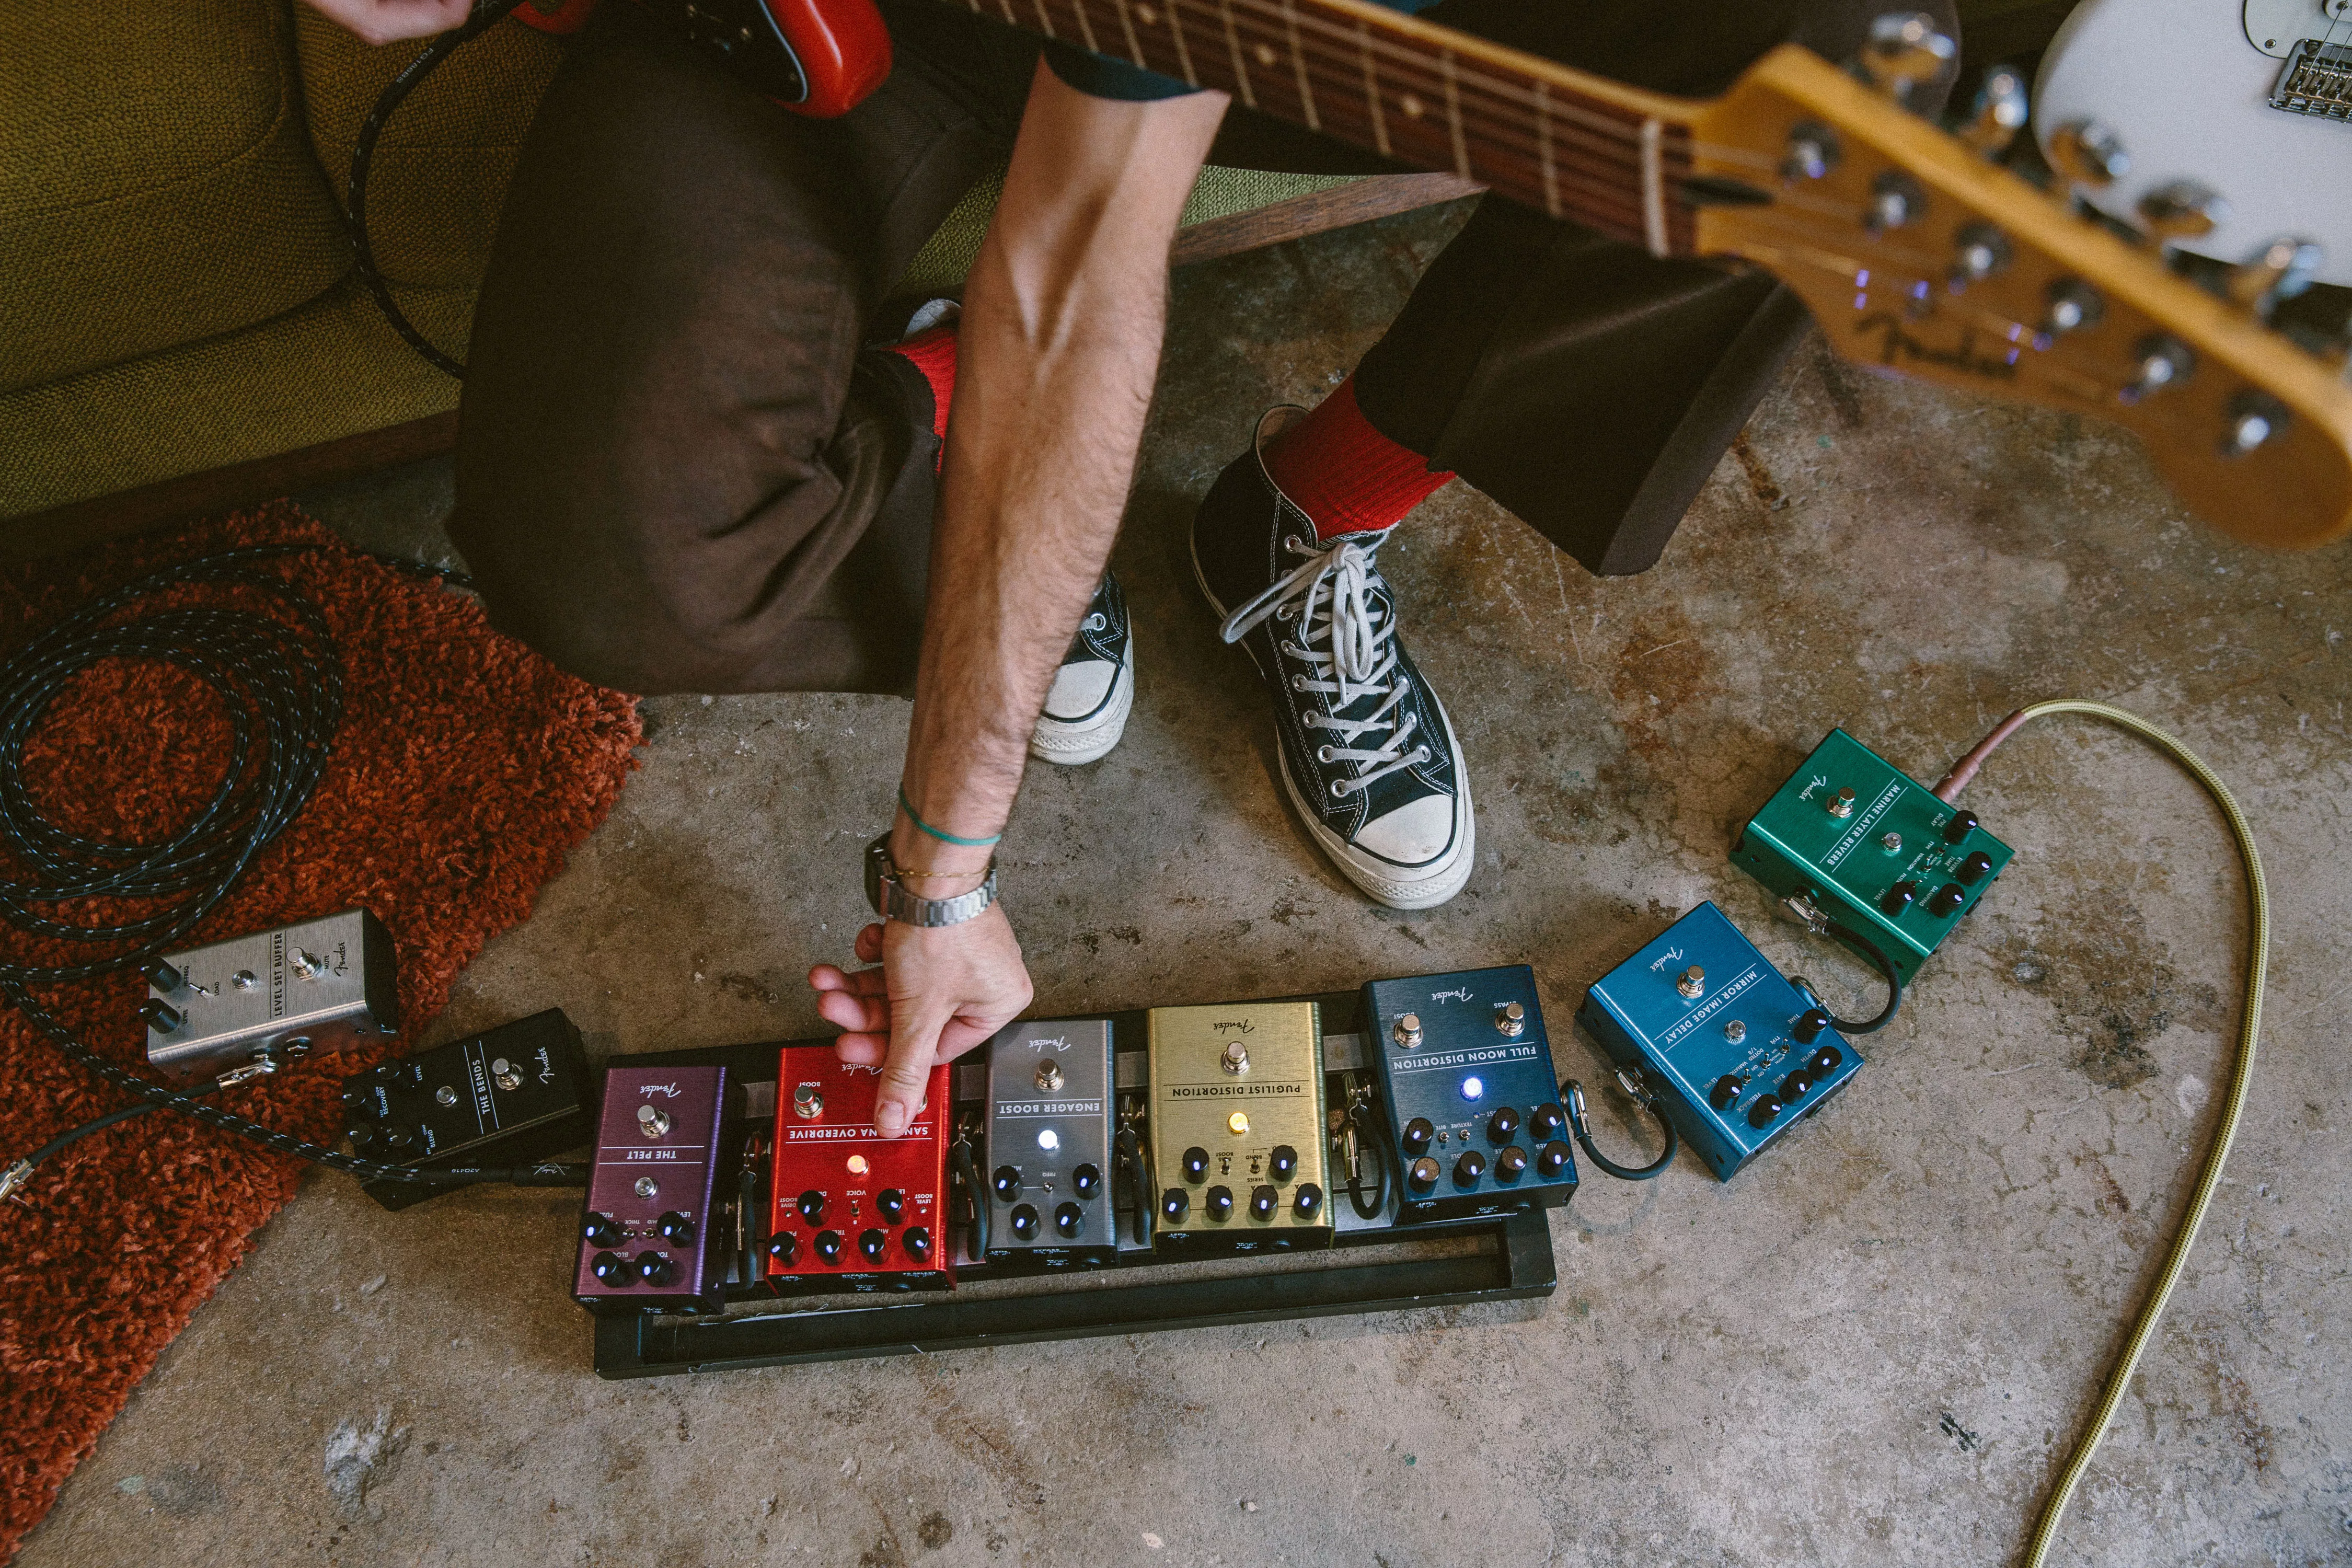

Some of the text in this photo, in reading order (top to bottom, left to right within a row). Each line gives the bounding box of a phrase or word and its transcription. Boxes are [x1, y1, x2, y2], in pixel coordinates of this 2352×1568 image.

[1798, 775, 1826, 801] Fender
[1827, 785, 1900, 865] MARINE LAYER REVERB
[1931, 813, 1944, 827] DELAY
[1938, 819, 1946, 827] PRE
[1925, 841, 1935, 850] TYPE
[1907, 853, 1924, 871] VARIATION
[1944, 856, 1955, 867] TIME
[1947, 857, 1963, 873] REVERB
[1874, 889, 1886, 901] LEVEL
[1919, 885, 1939, 907] DAMPING
[274, 932, 282, 966] BUFFER
[333, 942, 348, 977] Fender
[1650, 947, 1683, 972] Fender
[1432, 987, 1473, 1005] Fender
[1665, 971, 1757, 1044] MIRROR IMAGE DELAY
[1787, 1013, 1801, 1024] TIME
[1213, 1019, 1255, 1034] Fender
[1029, 1036, 1071, 1052] Fender
[1770, 1035, 1781, 1045] TYPE
[1394, 1046, 1536, 1070] FULL MOON DISTORTION
[1748, 1048, 1764, 1061] DOTTED
[1800, 1049, 1817, 1063] DEPTH
[535, 1047, 555, 1084] Fender
[1729, 1061, 1748, 1075] VARIATIO
[472, 1059, 490, 1114] THE BENDS
[1702, 1077, 1719, 1089] LEVEL
[1772, 1073, 1786, 1085] RATE
[640, 1082, 682, 1098] Fender
[1173, 1086, 1300, 1097] PUGILIST DISTORTION
[379, 1087, 389, 1115] RECOVERY
[999, 1103, 1100, 1114] ENGAGER BOOST
[1736, 1092, 1762, 1113] FEEDBACK
[790, 1129, 856, 1139] OVERDRIVE
[627, 1150, 676, 1159] THE PELT
